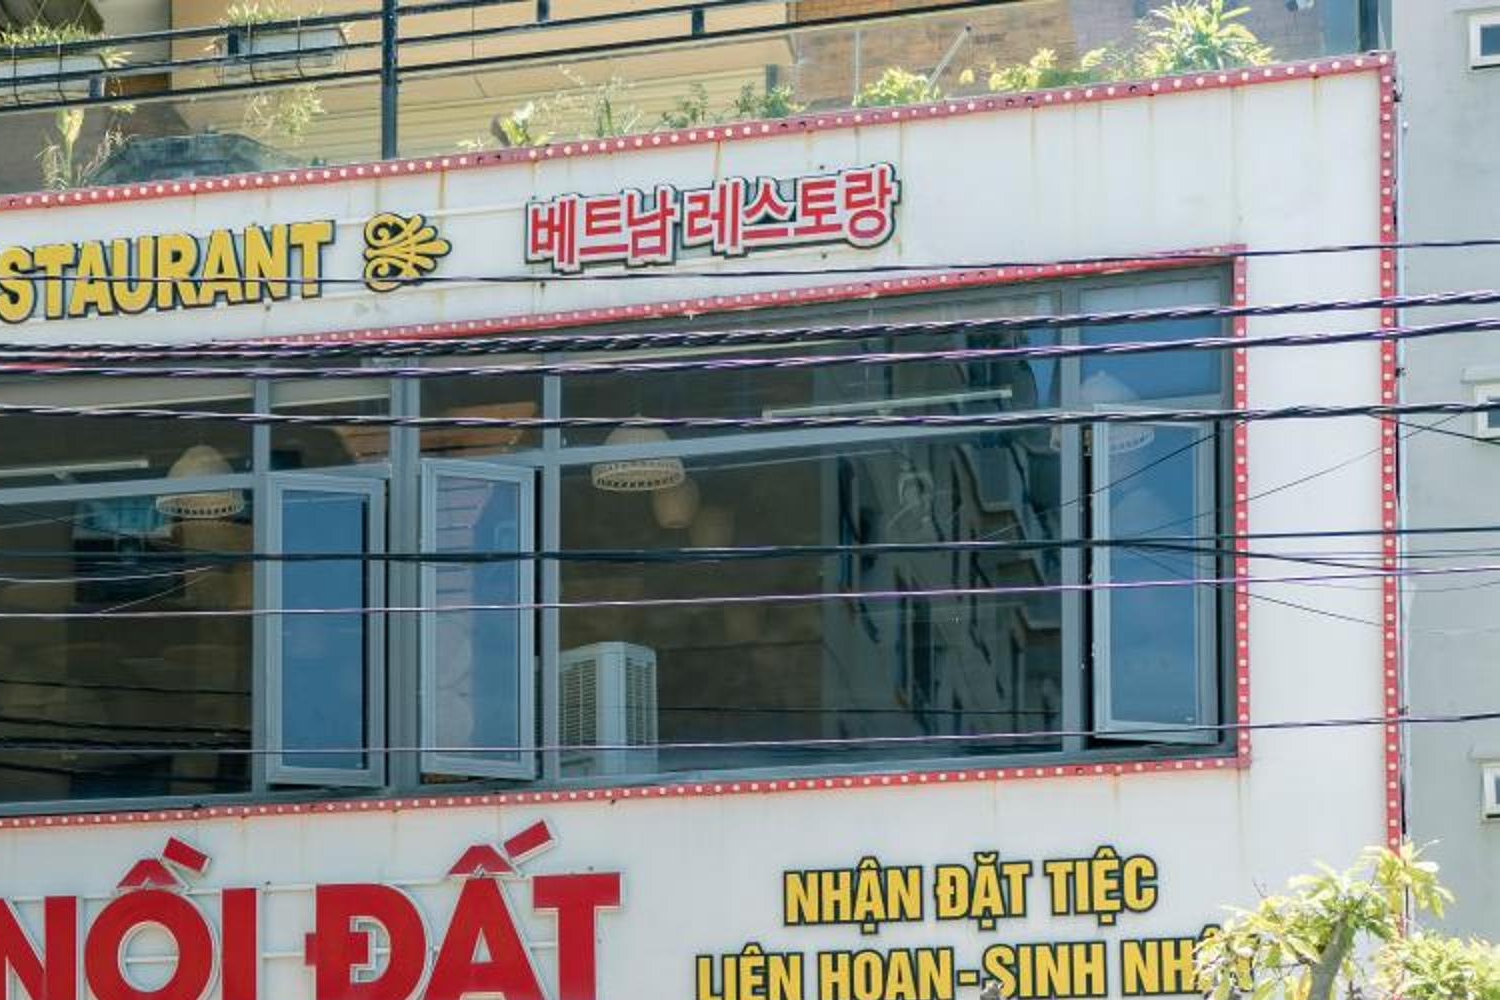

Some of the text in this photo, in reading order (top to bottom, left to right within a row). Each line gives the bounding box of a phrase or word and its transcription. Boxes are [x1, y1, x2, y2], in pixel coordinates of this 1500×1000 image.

[783, 846, 1158, 934] NHẬN ĐẶT TIỆC
[1121, 923, 1255, 998] NH
